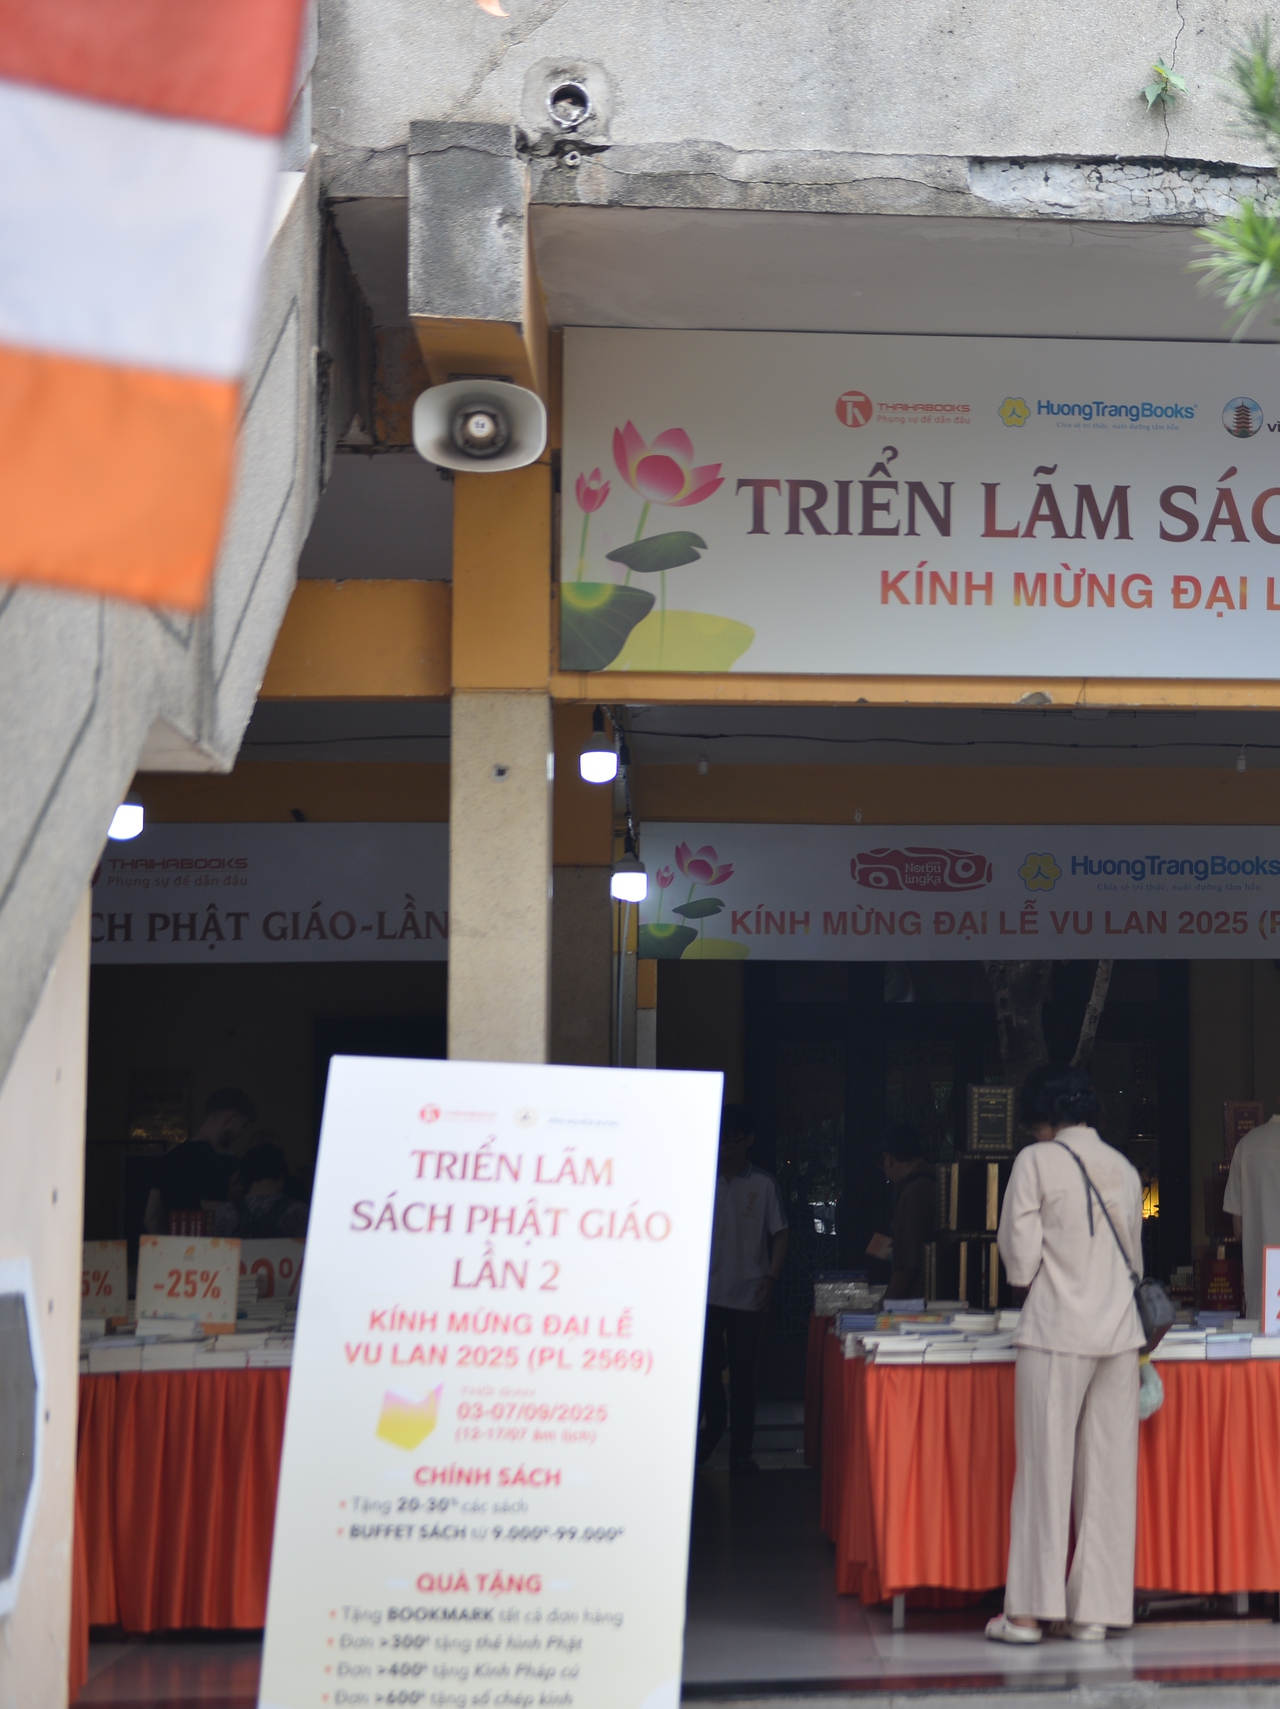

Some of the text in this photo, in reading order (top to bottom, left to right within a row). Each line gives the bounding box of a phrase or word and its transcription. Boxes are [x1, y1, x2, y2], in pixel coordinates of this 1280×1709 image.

[877, 403, 970, 413] THAIHABOOKS
[1037, 400, 1195, 422] HuongTrangBooks
[735, 445, 955, 537] TRIỂN
[980, 464, 1134, 541] LÃM
[879, 561, 994, 606] KÍNH
[1013, 563, 1154, 609] MỪNG
[1171, 575, 1248, 618] ĐẠI
[109, 858, 248, 870] THAIHABOOKS
[904, 861, 942, 874] Norbu
[904, 872, 942, 887] lingka
[91, 912, 132, 942] CH
[147, 903, 250, 950] PHẬT
[730, 904, 810, 935] KÍNH
[823, 906, 922, 936] MỪNG
[933, 911, 987, 940] ĐẠI
[999, 900, 1039, 935] LỄ
[1050, 910, 1093, 935] VU
[1105, 910, 1167, 935] LAN
[1178, 910, 1249, 935] 2025
[412, 1134, 614, 1186] TRIỂN LÃM
[350, 1190, 672, 1247] SÁCH PHẬT GIÁO
[452, 1239, 561, 1291] LẦN 2
[153, 1269, 222, 1299] -25%
[369, 1304, 634, 1341] KÍNH MỪNG ĐẠI LỄ
[345, 1343, 653, 1375] VU LAN 2025 (PL 2569)
[457, 1402, 608, 1423] 03-07/09/2025
[414, 1462, 562, 1487] CHÍNH SÁCH
[349, 1524, 416, 1540] BUFFET
[419, 1521, 467, 1540] SÁCH
[416, 1569, 542, 1598] QUÀ TẶNG
[387, 1606, 495, 1623] BOOKMARK
